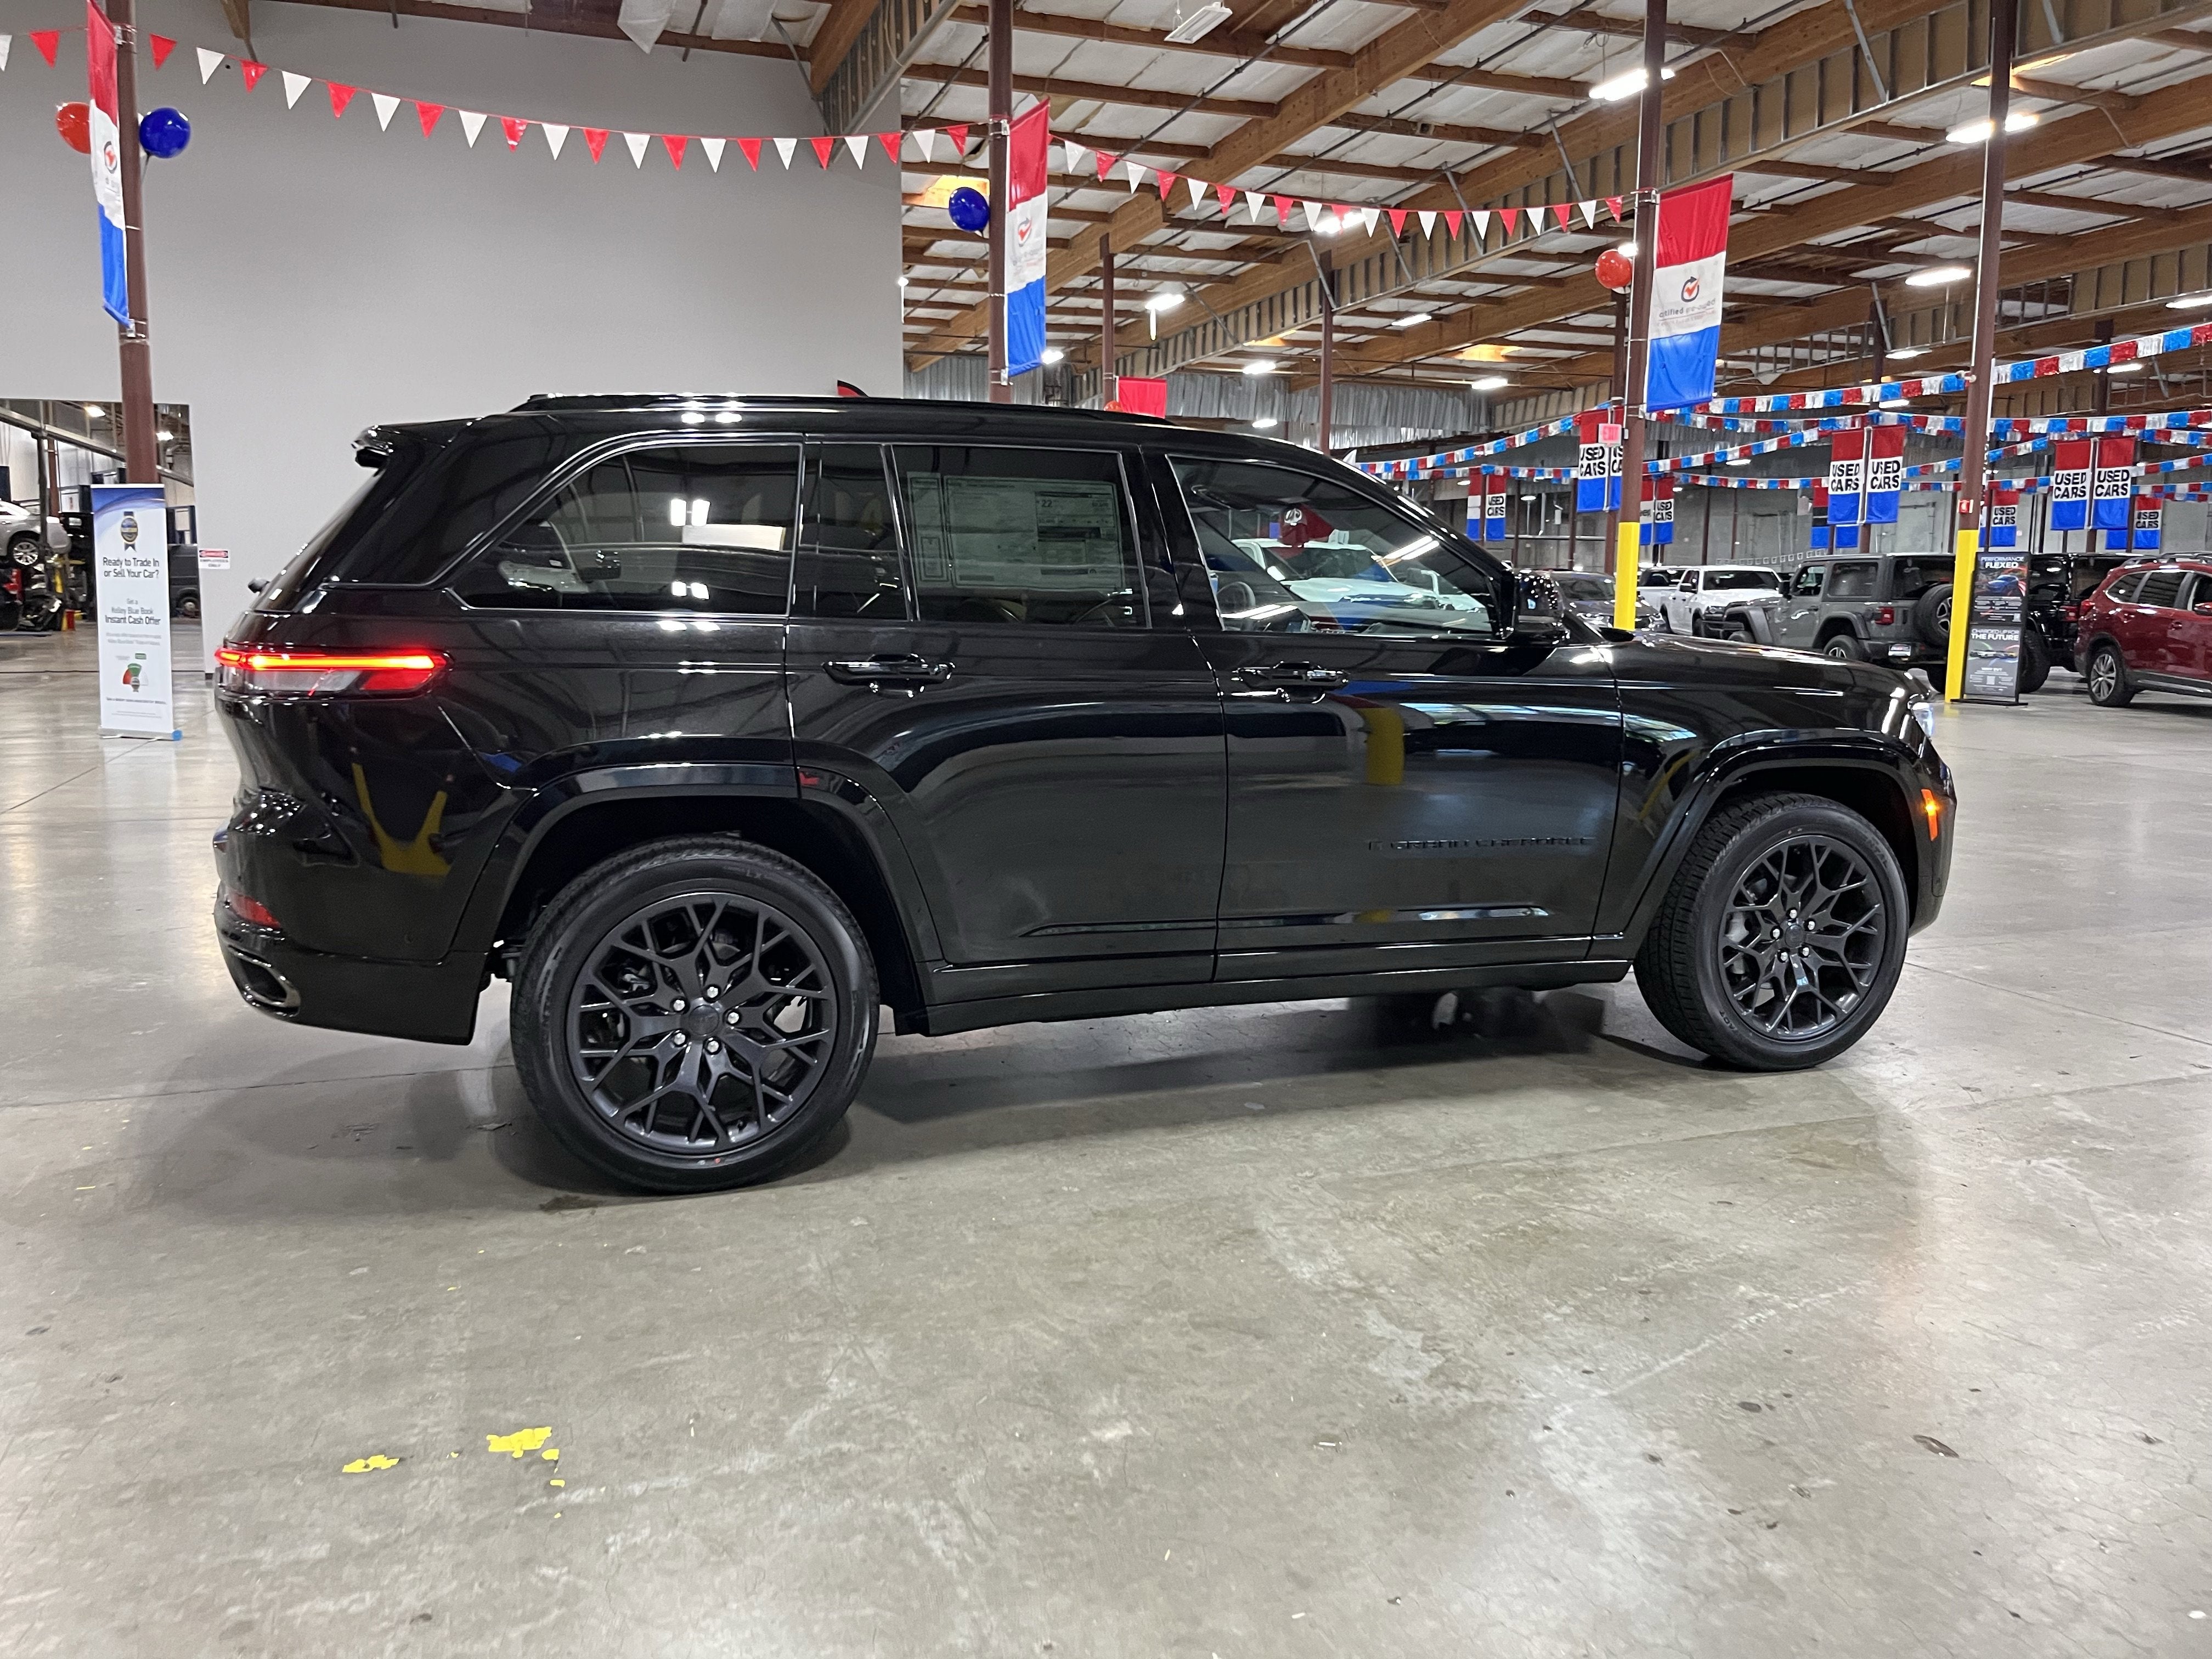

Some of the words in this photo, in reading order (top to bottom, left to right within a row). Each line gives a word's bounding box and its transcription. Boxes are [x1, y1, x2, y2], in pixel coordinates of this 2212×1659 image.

[1613, 445, 1623, 458] US
[1612, 459, 1622, 473] CA
[1832, 464, 1860, 477] USED
[1872, 460, 1901, 475] USED
[1870, 475, 1900, 490] CARS
[2055, 472, 2086, 486] USED
[2097, 469, 2130, 483] USED
[1831, 477, 1859, 492] CARS
[2095, 483, 2128, 497] CARS
[2054, 486, 2086, 499] CARS
[1488, 495, 1504, 505] USED
[1994, 506, 2016, 516] USED
[2137, 511, 2159, 520] USED
[1993, 516, 2016, 525] CARS
[103, 557, 122, 568] Ready
[125, 558, 132, 566] to
[132, 557, 151, 567] Trade
[153, 558, 160, 567] In
[113, 568, 125, 578] Sell
[127, 568, 142, 578] Your
[143, 569, 159, 578] Car?
[105, 614, 127, 624] Instant
[128, 616, 143, 624] Cash
[145, 616, 161, 625] Offer
